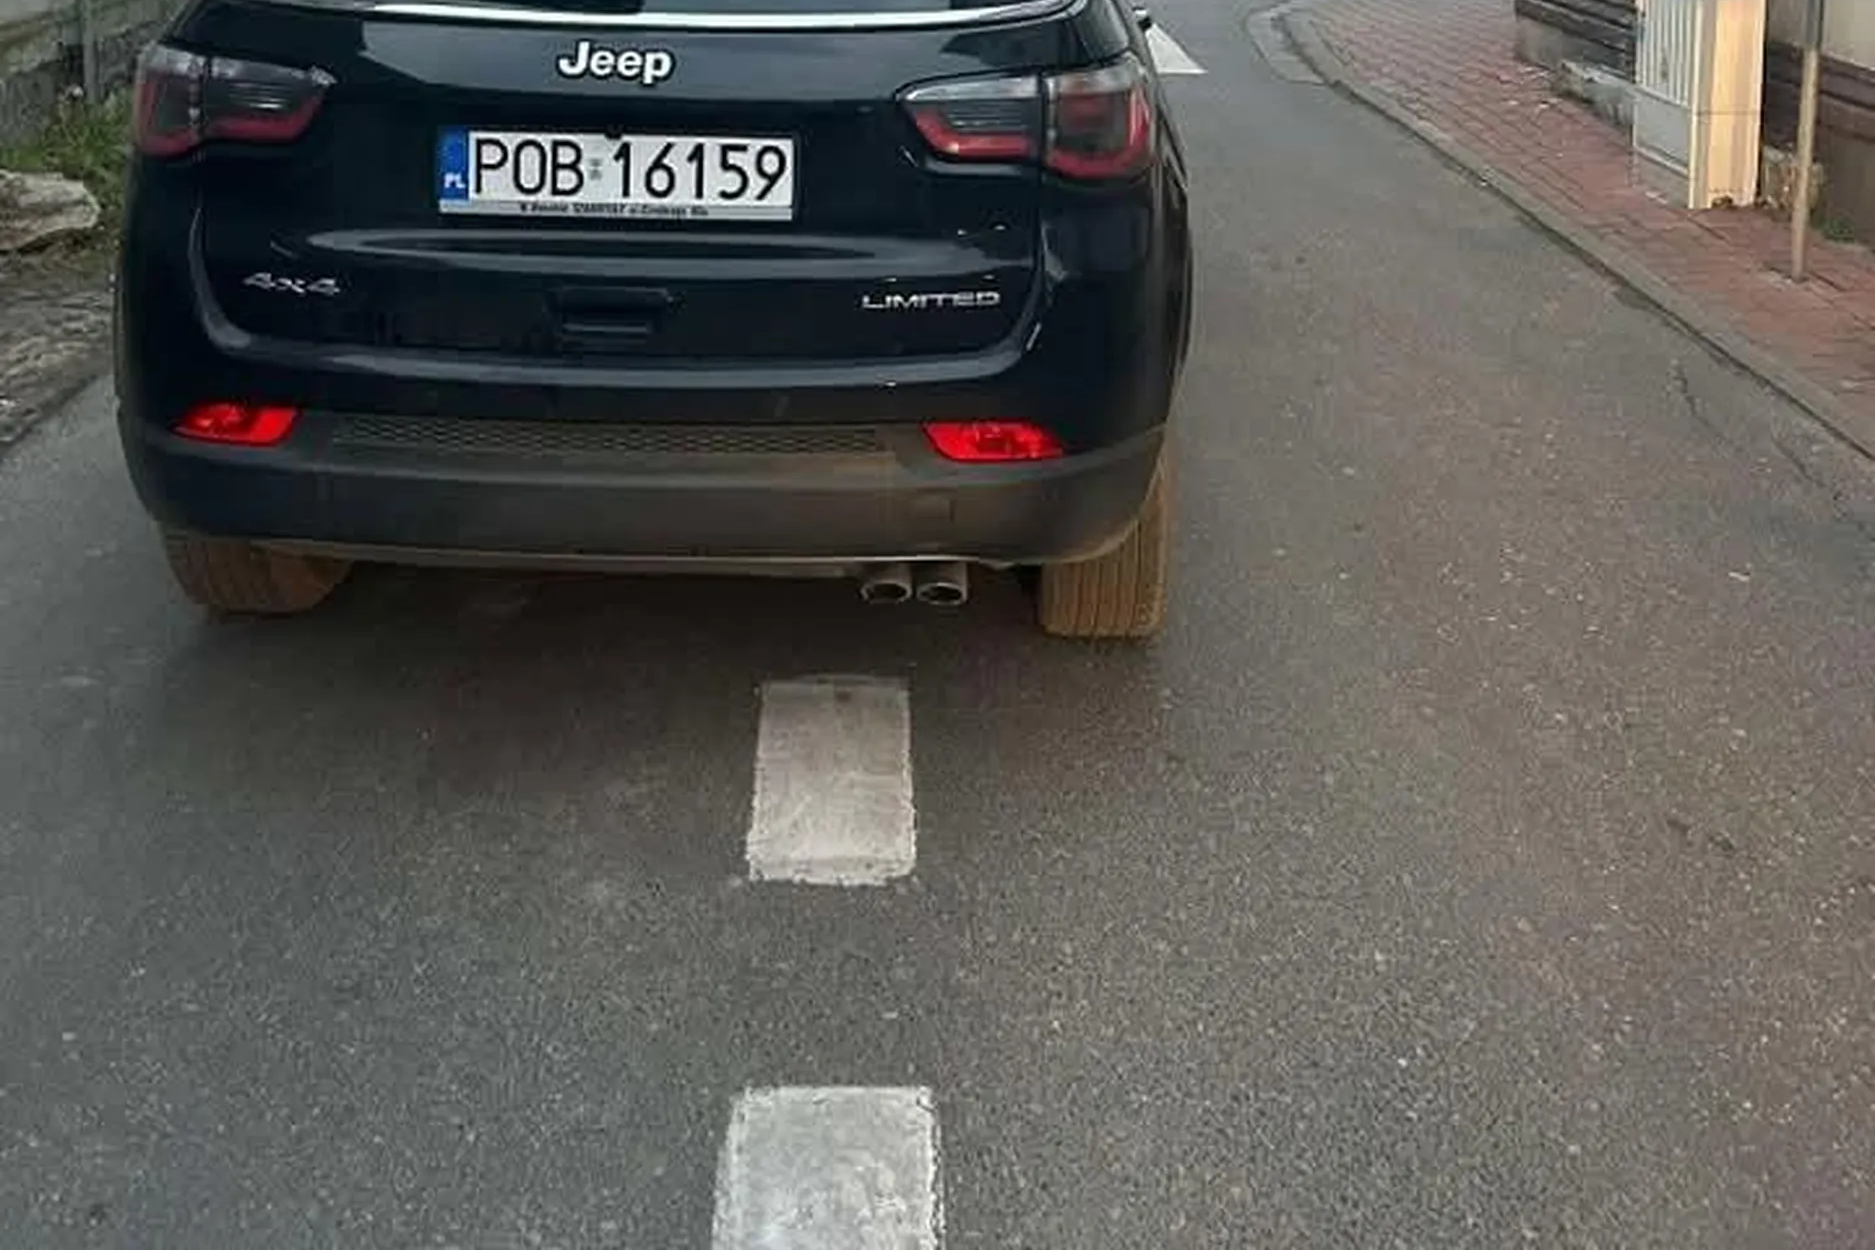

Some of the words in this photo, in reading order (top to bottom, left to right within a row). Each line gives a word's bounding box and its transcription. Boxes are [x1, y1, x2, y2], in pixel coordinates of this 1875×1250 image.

[557, 40, 675, 85] Jeep
[444, 171, 467, 189] PL
[474, 137, 585, 197] POB
[612, 141, 787, 201] 16159
[861, 290, 1001, 309] LIMITED
